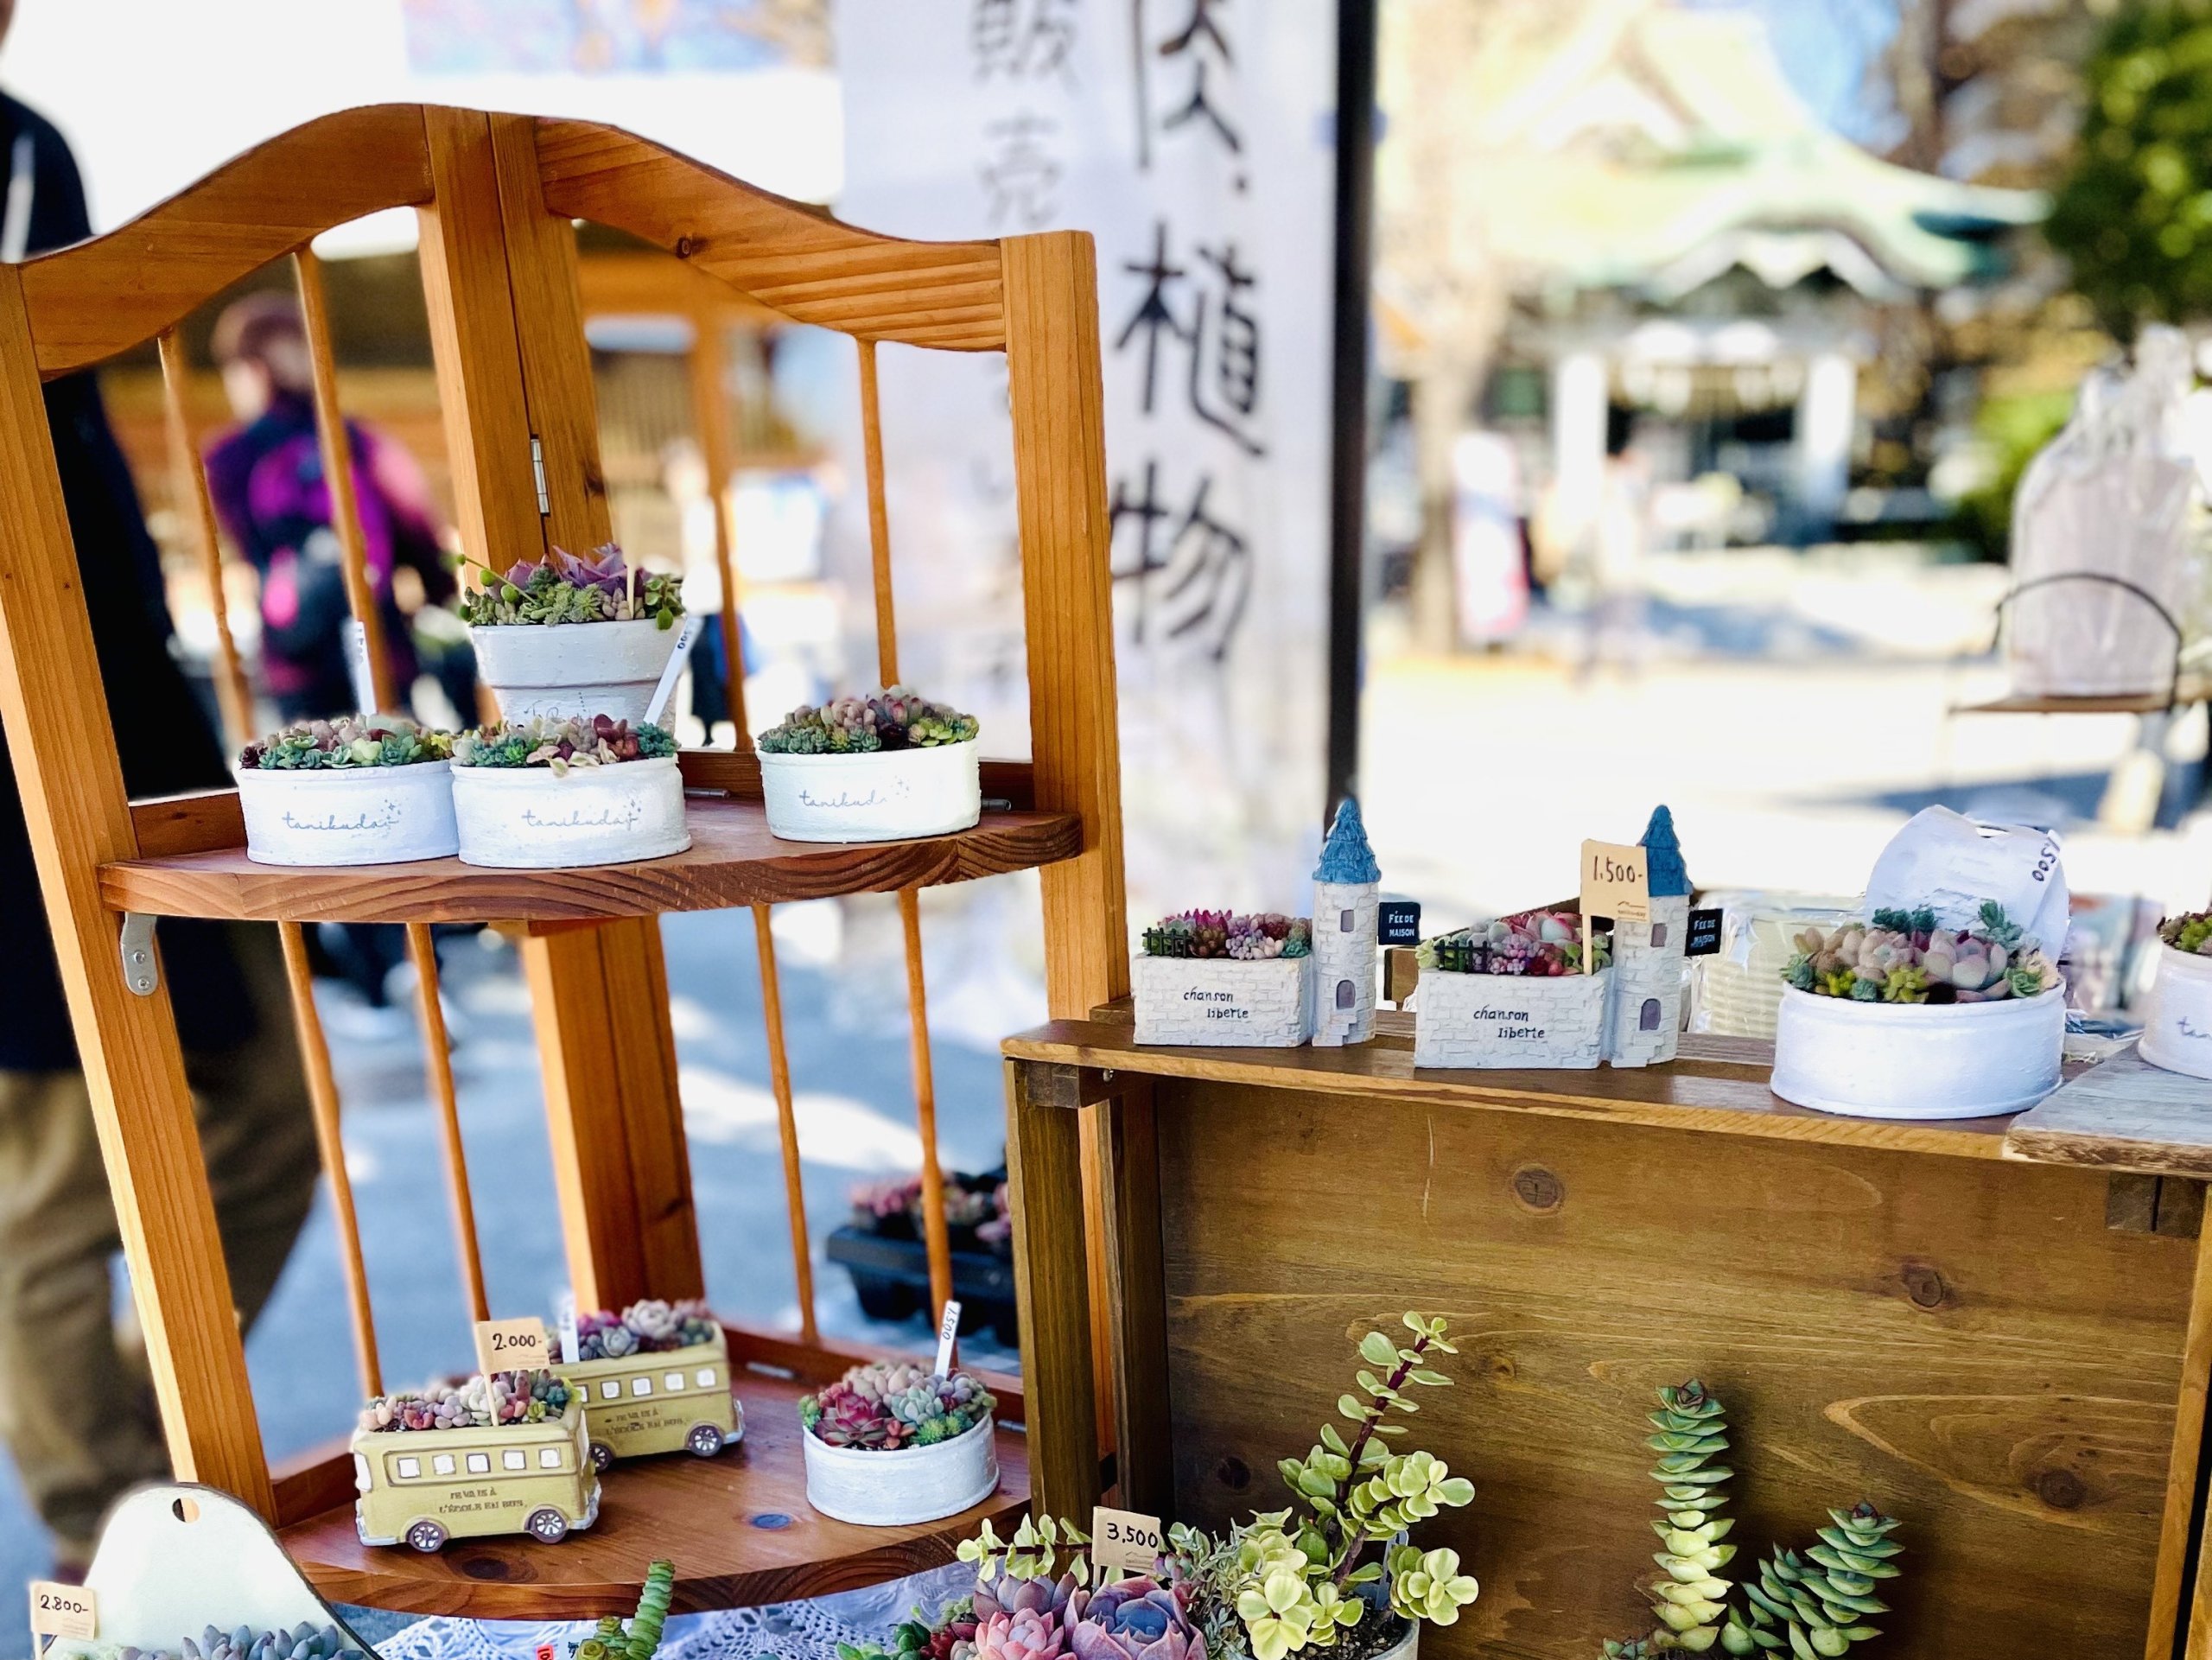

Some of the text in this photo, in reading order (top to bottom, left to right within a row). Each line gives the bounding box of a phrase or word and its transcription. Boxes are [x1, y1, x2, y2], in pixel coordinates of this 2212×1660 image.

[1404, 914, 1414, 924] DE
[1389, 928, 1414, 938] MAISON
[1183, 986, 1234, 1003] chanson
[1473, 1004, 1529, 1022] chanson
